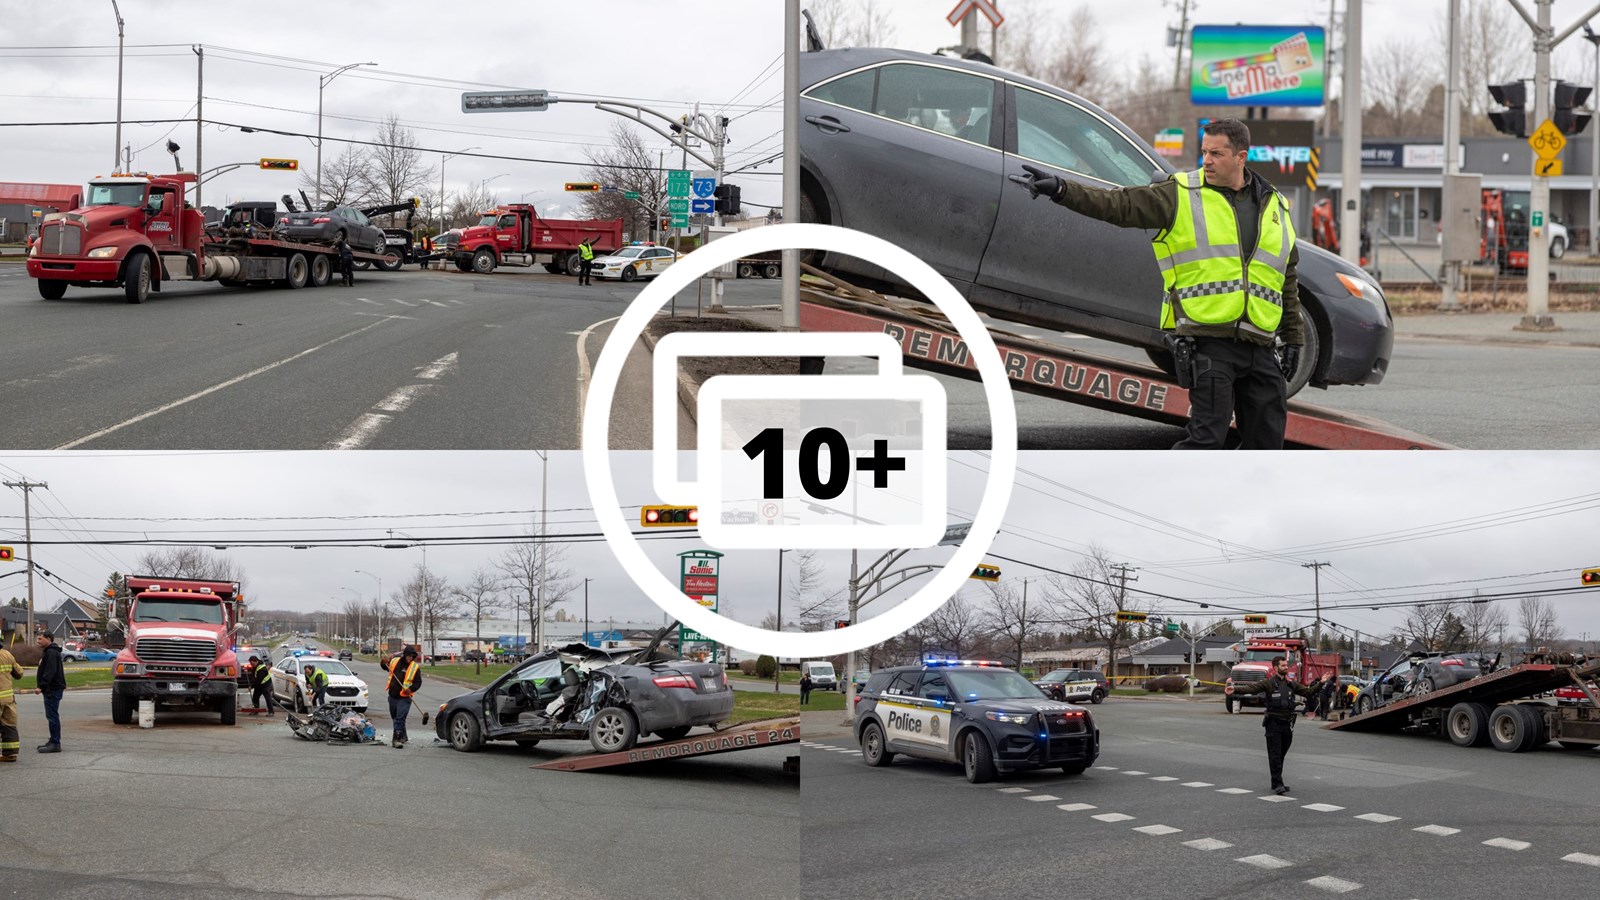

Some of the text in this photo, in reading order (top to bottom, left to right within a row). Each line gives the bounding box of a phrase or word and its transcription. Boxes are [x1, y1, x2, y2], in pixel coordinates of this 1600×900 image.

[670, 182, 688, 193] 173
[696, 181, 713, 192] 73
[883, 321, 1168, 411] REMRQUAGE
[684, 632, 711, 641] LAVE-AU
[888, 711, 922, 733] Police
[628, 727, 794, 763] REMORQUAGE 24
